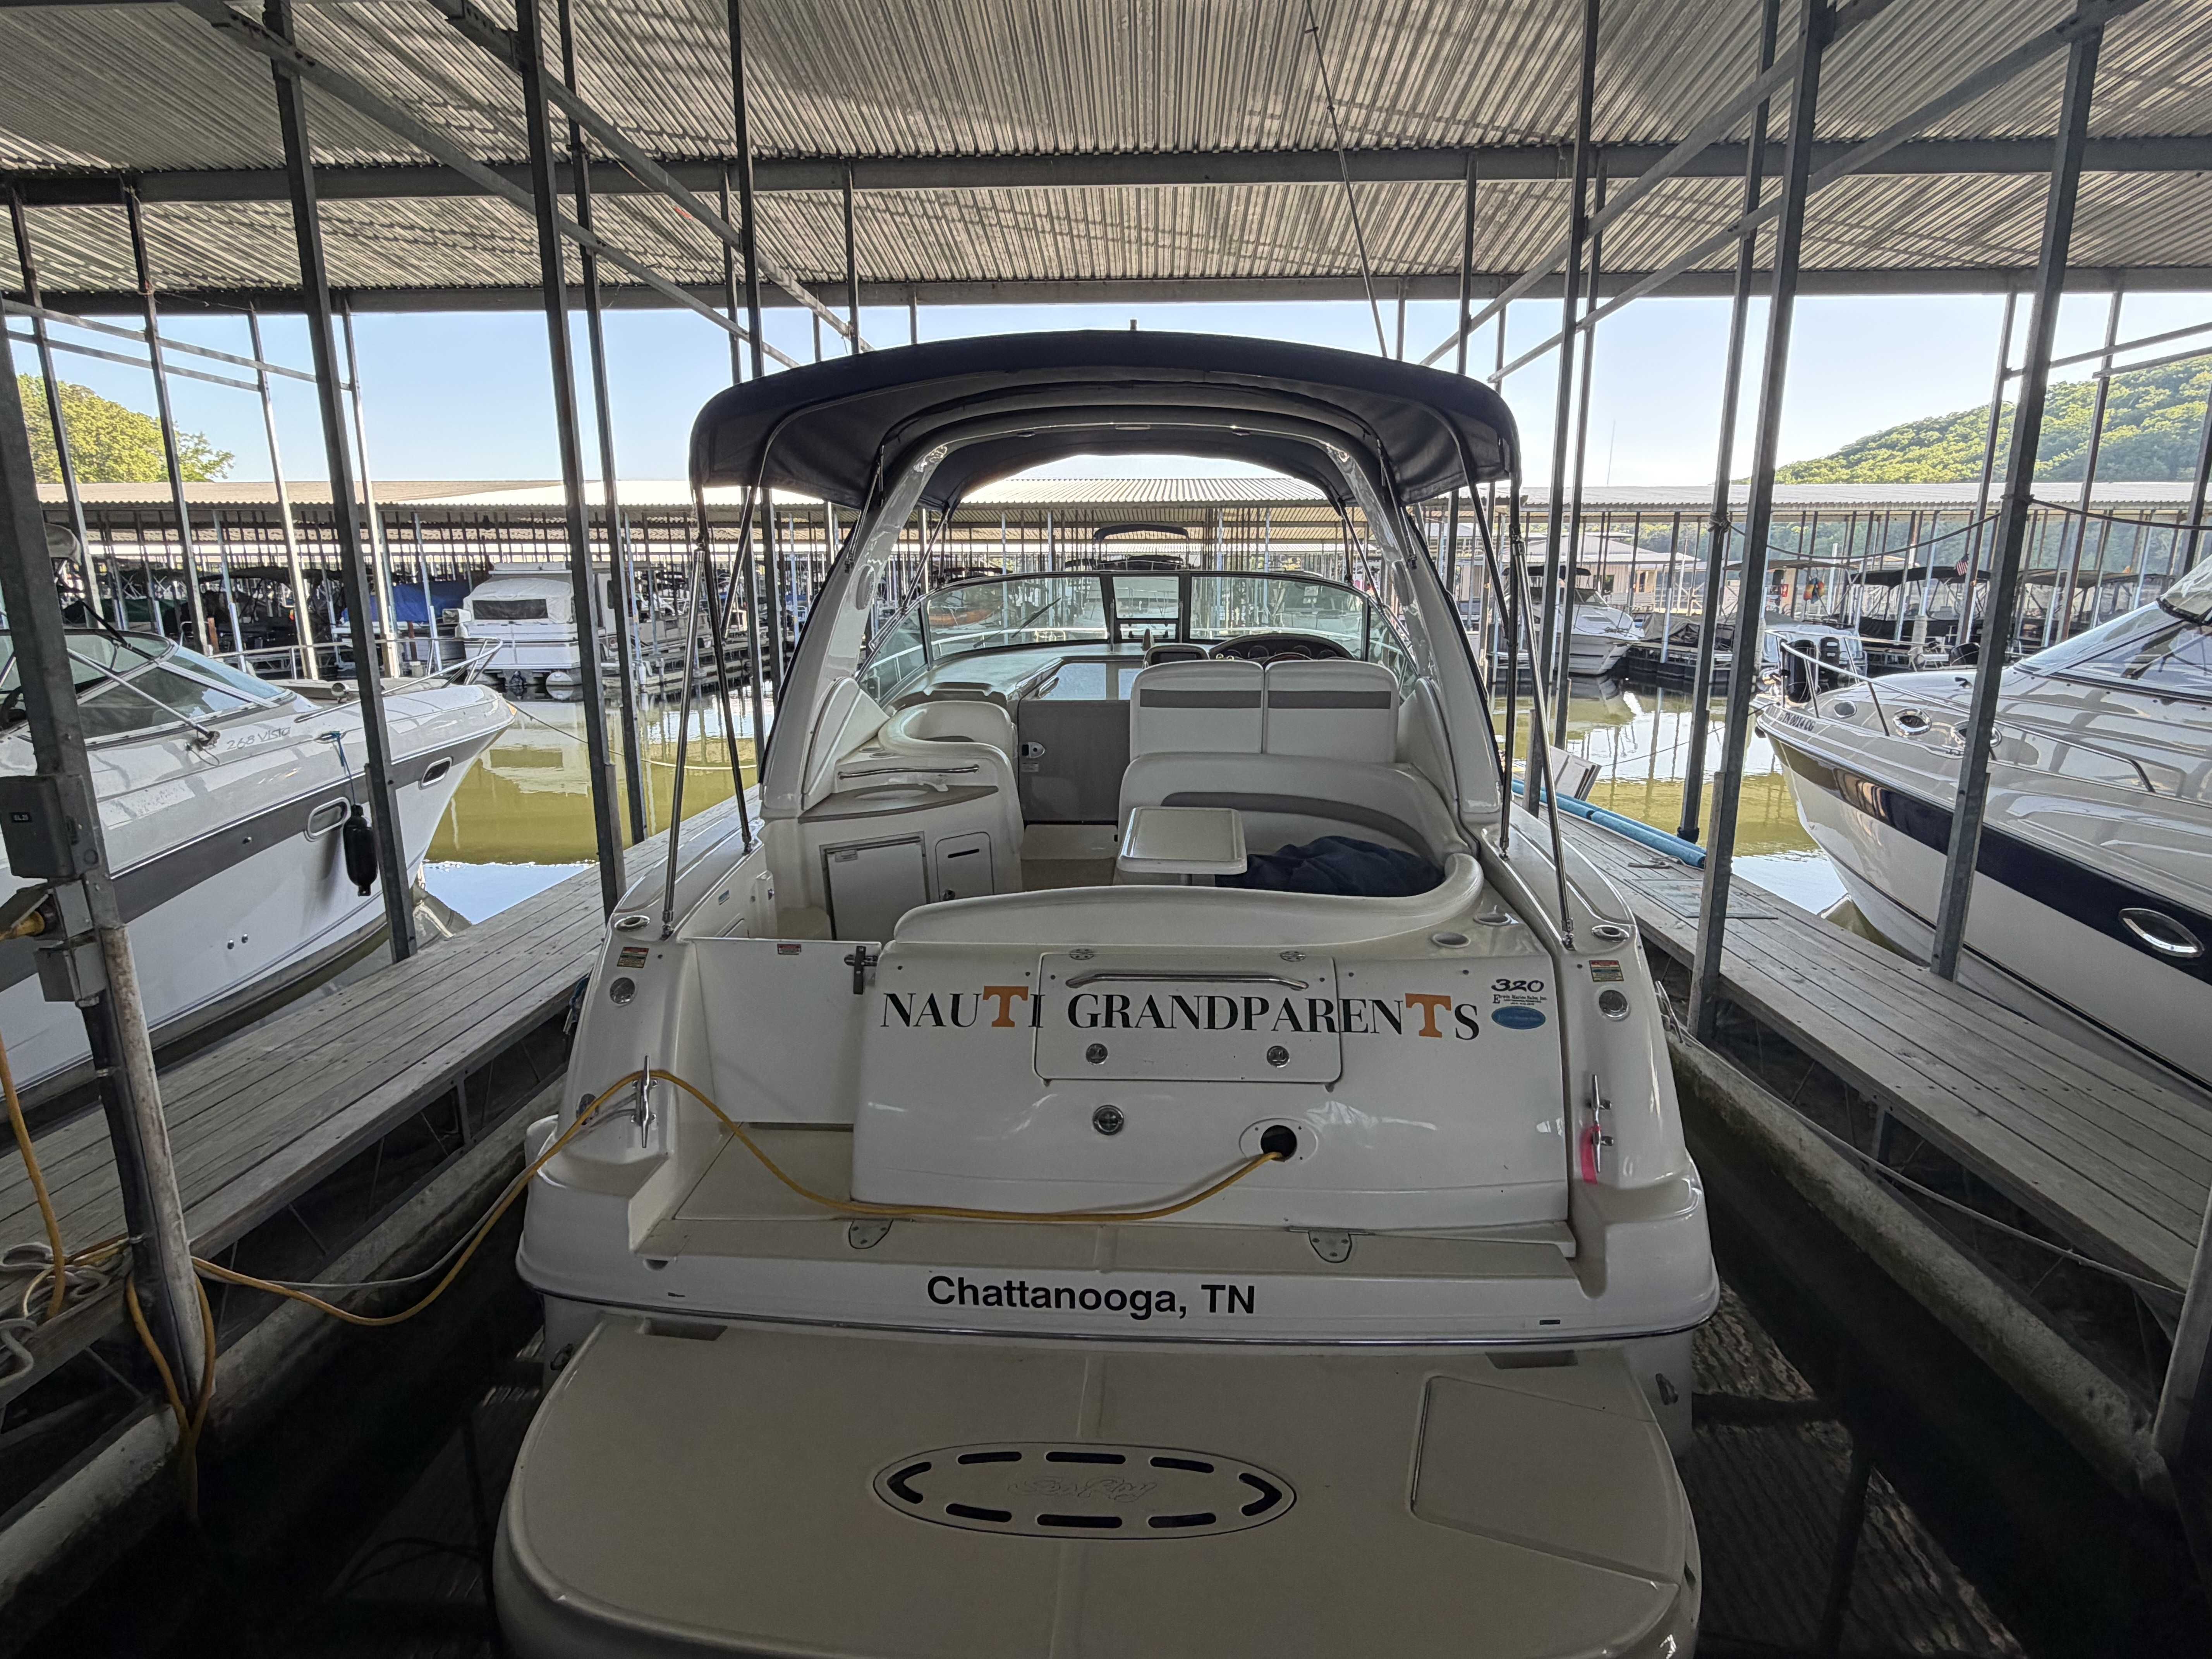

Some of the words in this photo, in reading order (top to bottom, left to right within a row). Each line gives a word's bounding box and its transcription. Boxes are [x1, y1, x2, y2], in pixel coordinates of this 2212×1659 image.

[227, 735, 255, 750] 268
[1491, 979, 1544, 992] 320
[880, 986, 1045, 1028] NAUTI
[1068, 993, 1479, 1040] GRANDPARENTS
[928, 1276, 1186, 1320] Chattanooga,
[1201, 1285, 1254, 1314] TN
